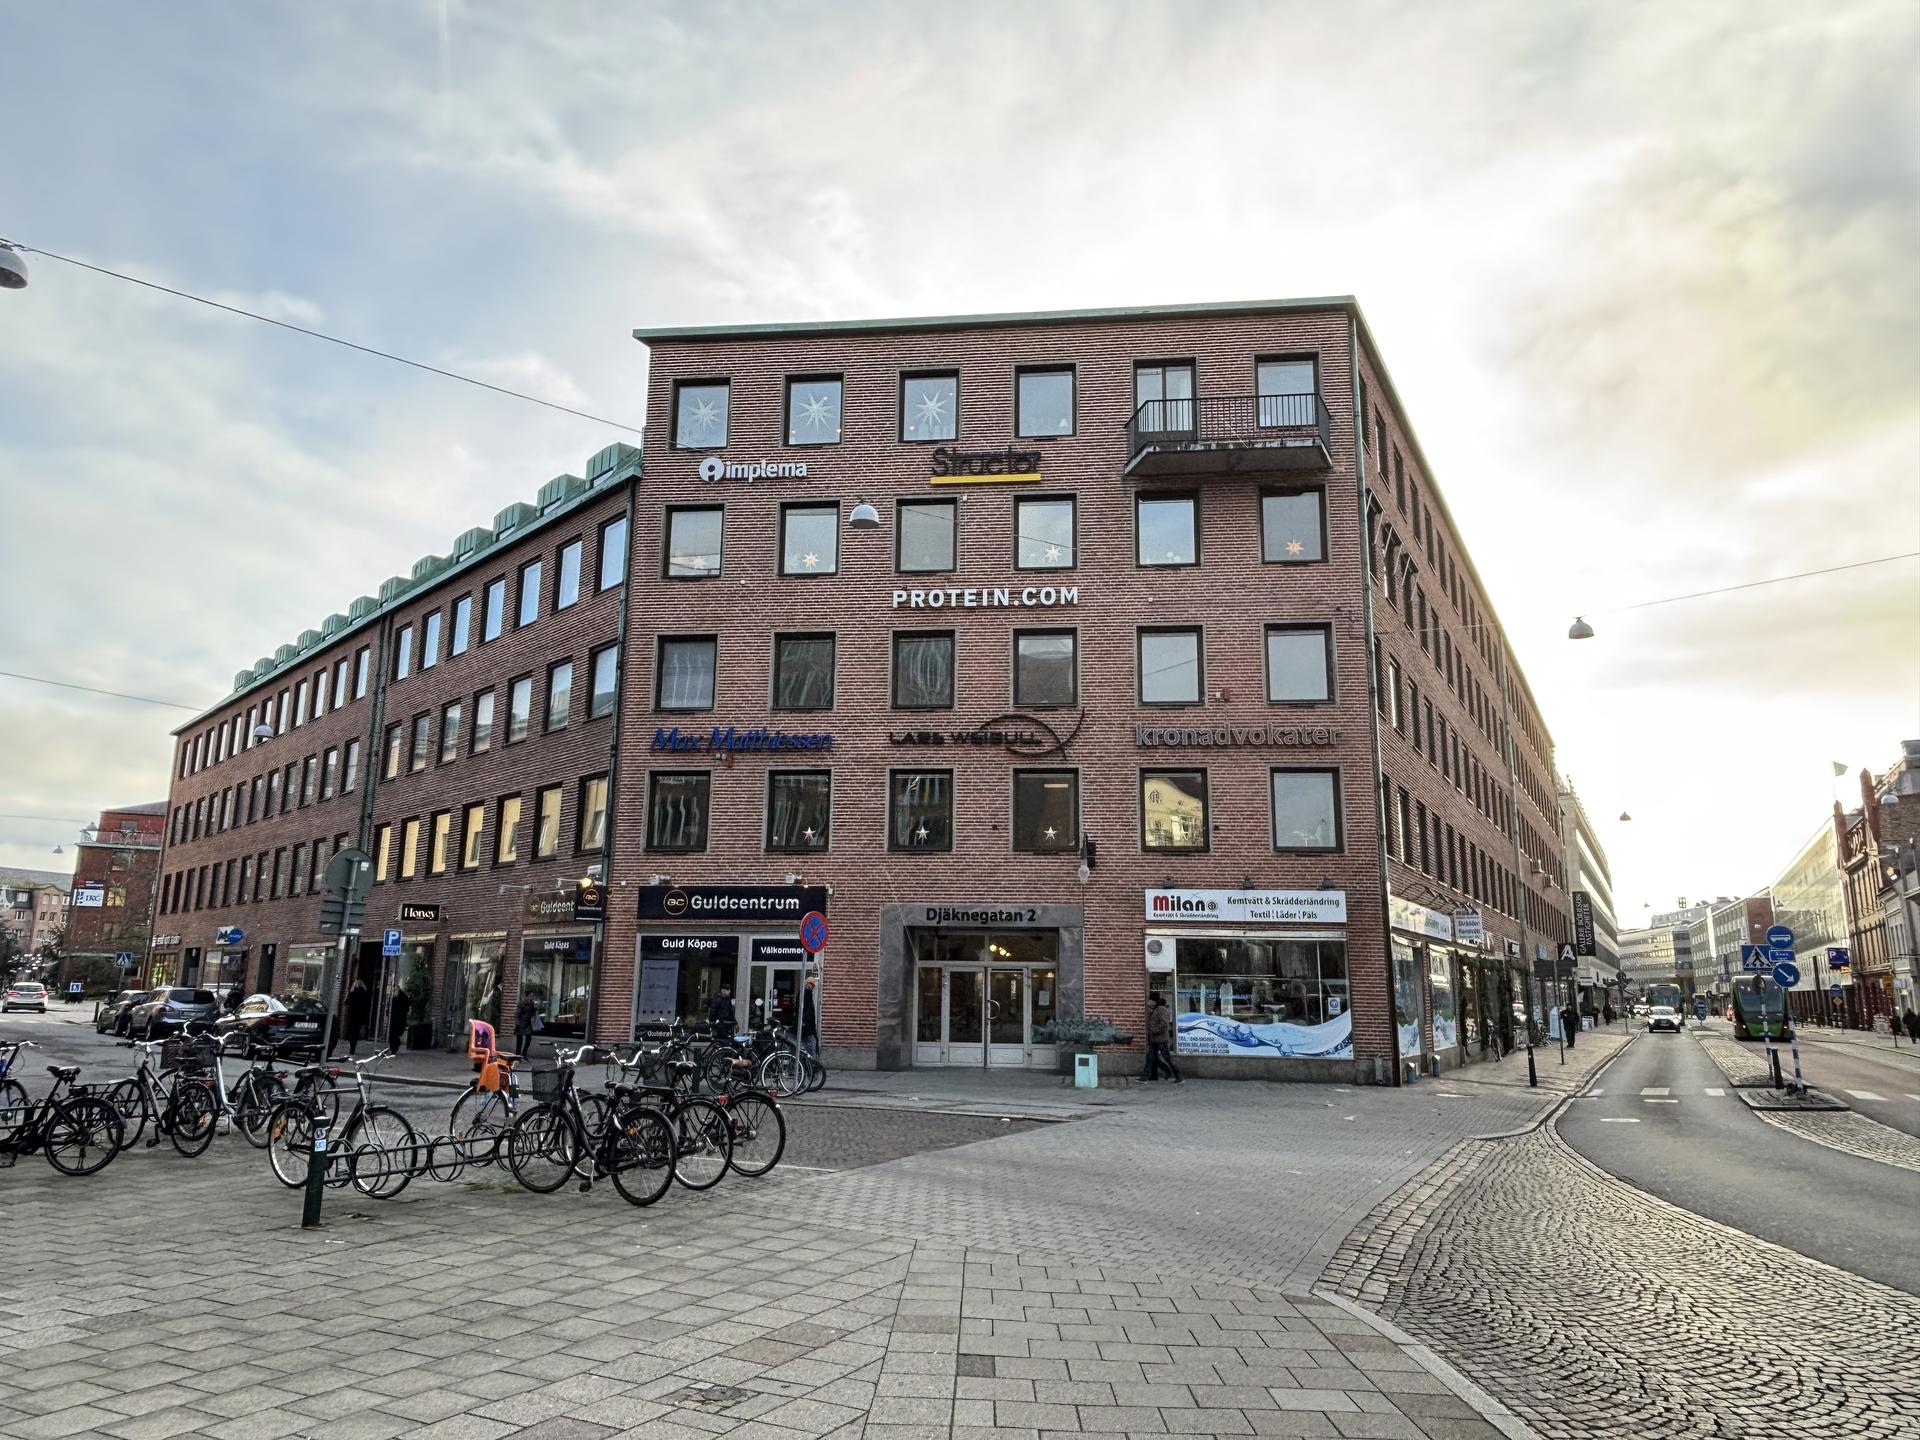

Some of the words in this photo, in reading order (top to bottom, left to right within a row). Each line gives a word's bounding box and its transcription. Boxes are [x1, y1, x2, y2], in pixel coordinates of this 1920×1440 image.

[725, 459, 808, 482] implema
[892, 587, 1079, 608] PROTEIN.COM
[707, 726, 833, 749] Matthiessen
[1136, 720, 1340, 746] kronadvokater
[541, 901, 575, 914] Guldcent
[691, 895, 800, 910] Guldcentrum
[1227, 896, 1263, 906] Kemtvätt
[1265, 897, 1271, 905] &
[1272, 897, 1340, 908] Skrädderiändring
[404, 907, 436, 920] Honey
[926, 907, 1023, 925] Djäknegatan
[1027, 909, 1036, 922] 2
[1250, 911, 1271, 919] Textil
[1276, 911, 1297, 919] Läder
[1302, 911, 1318, 919] Päls
[388, 931, 399, 945] P
[662, 938, 685, 948] Guld
[687, 938, 718, 950] Köpes
